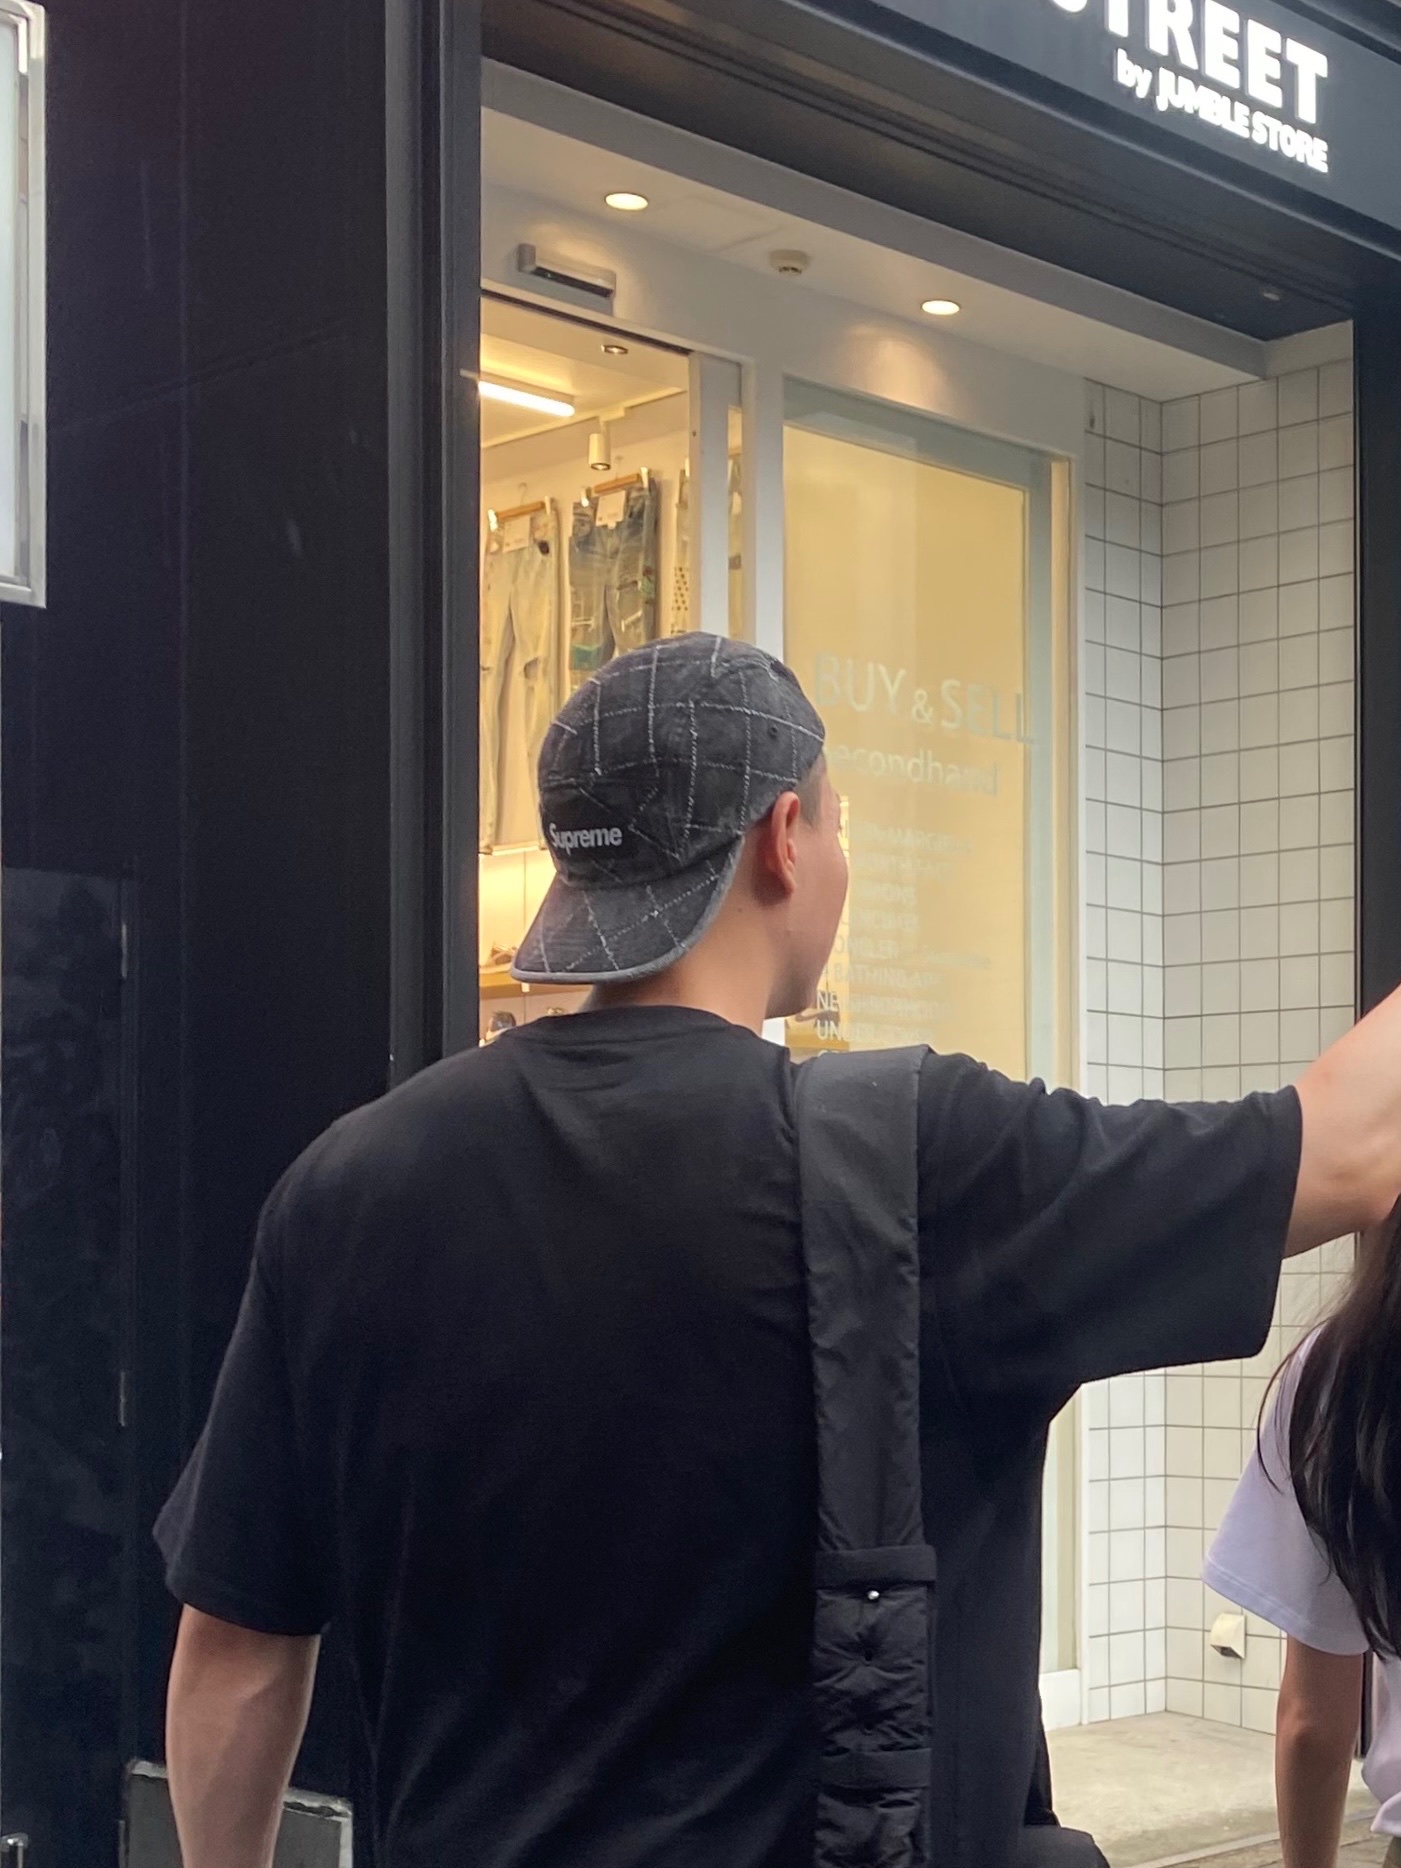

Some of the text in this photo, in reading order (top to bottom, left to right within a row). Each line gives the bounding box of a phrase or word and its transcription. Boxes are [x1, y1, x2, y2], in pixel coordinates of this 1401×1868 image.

[1052, 0, 1328, 124] REET
[1114, 48, 1328, 173] by JUMBLE STORE
[549, 823, 622, 855] Supreme
